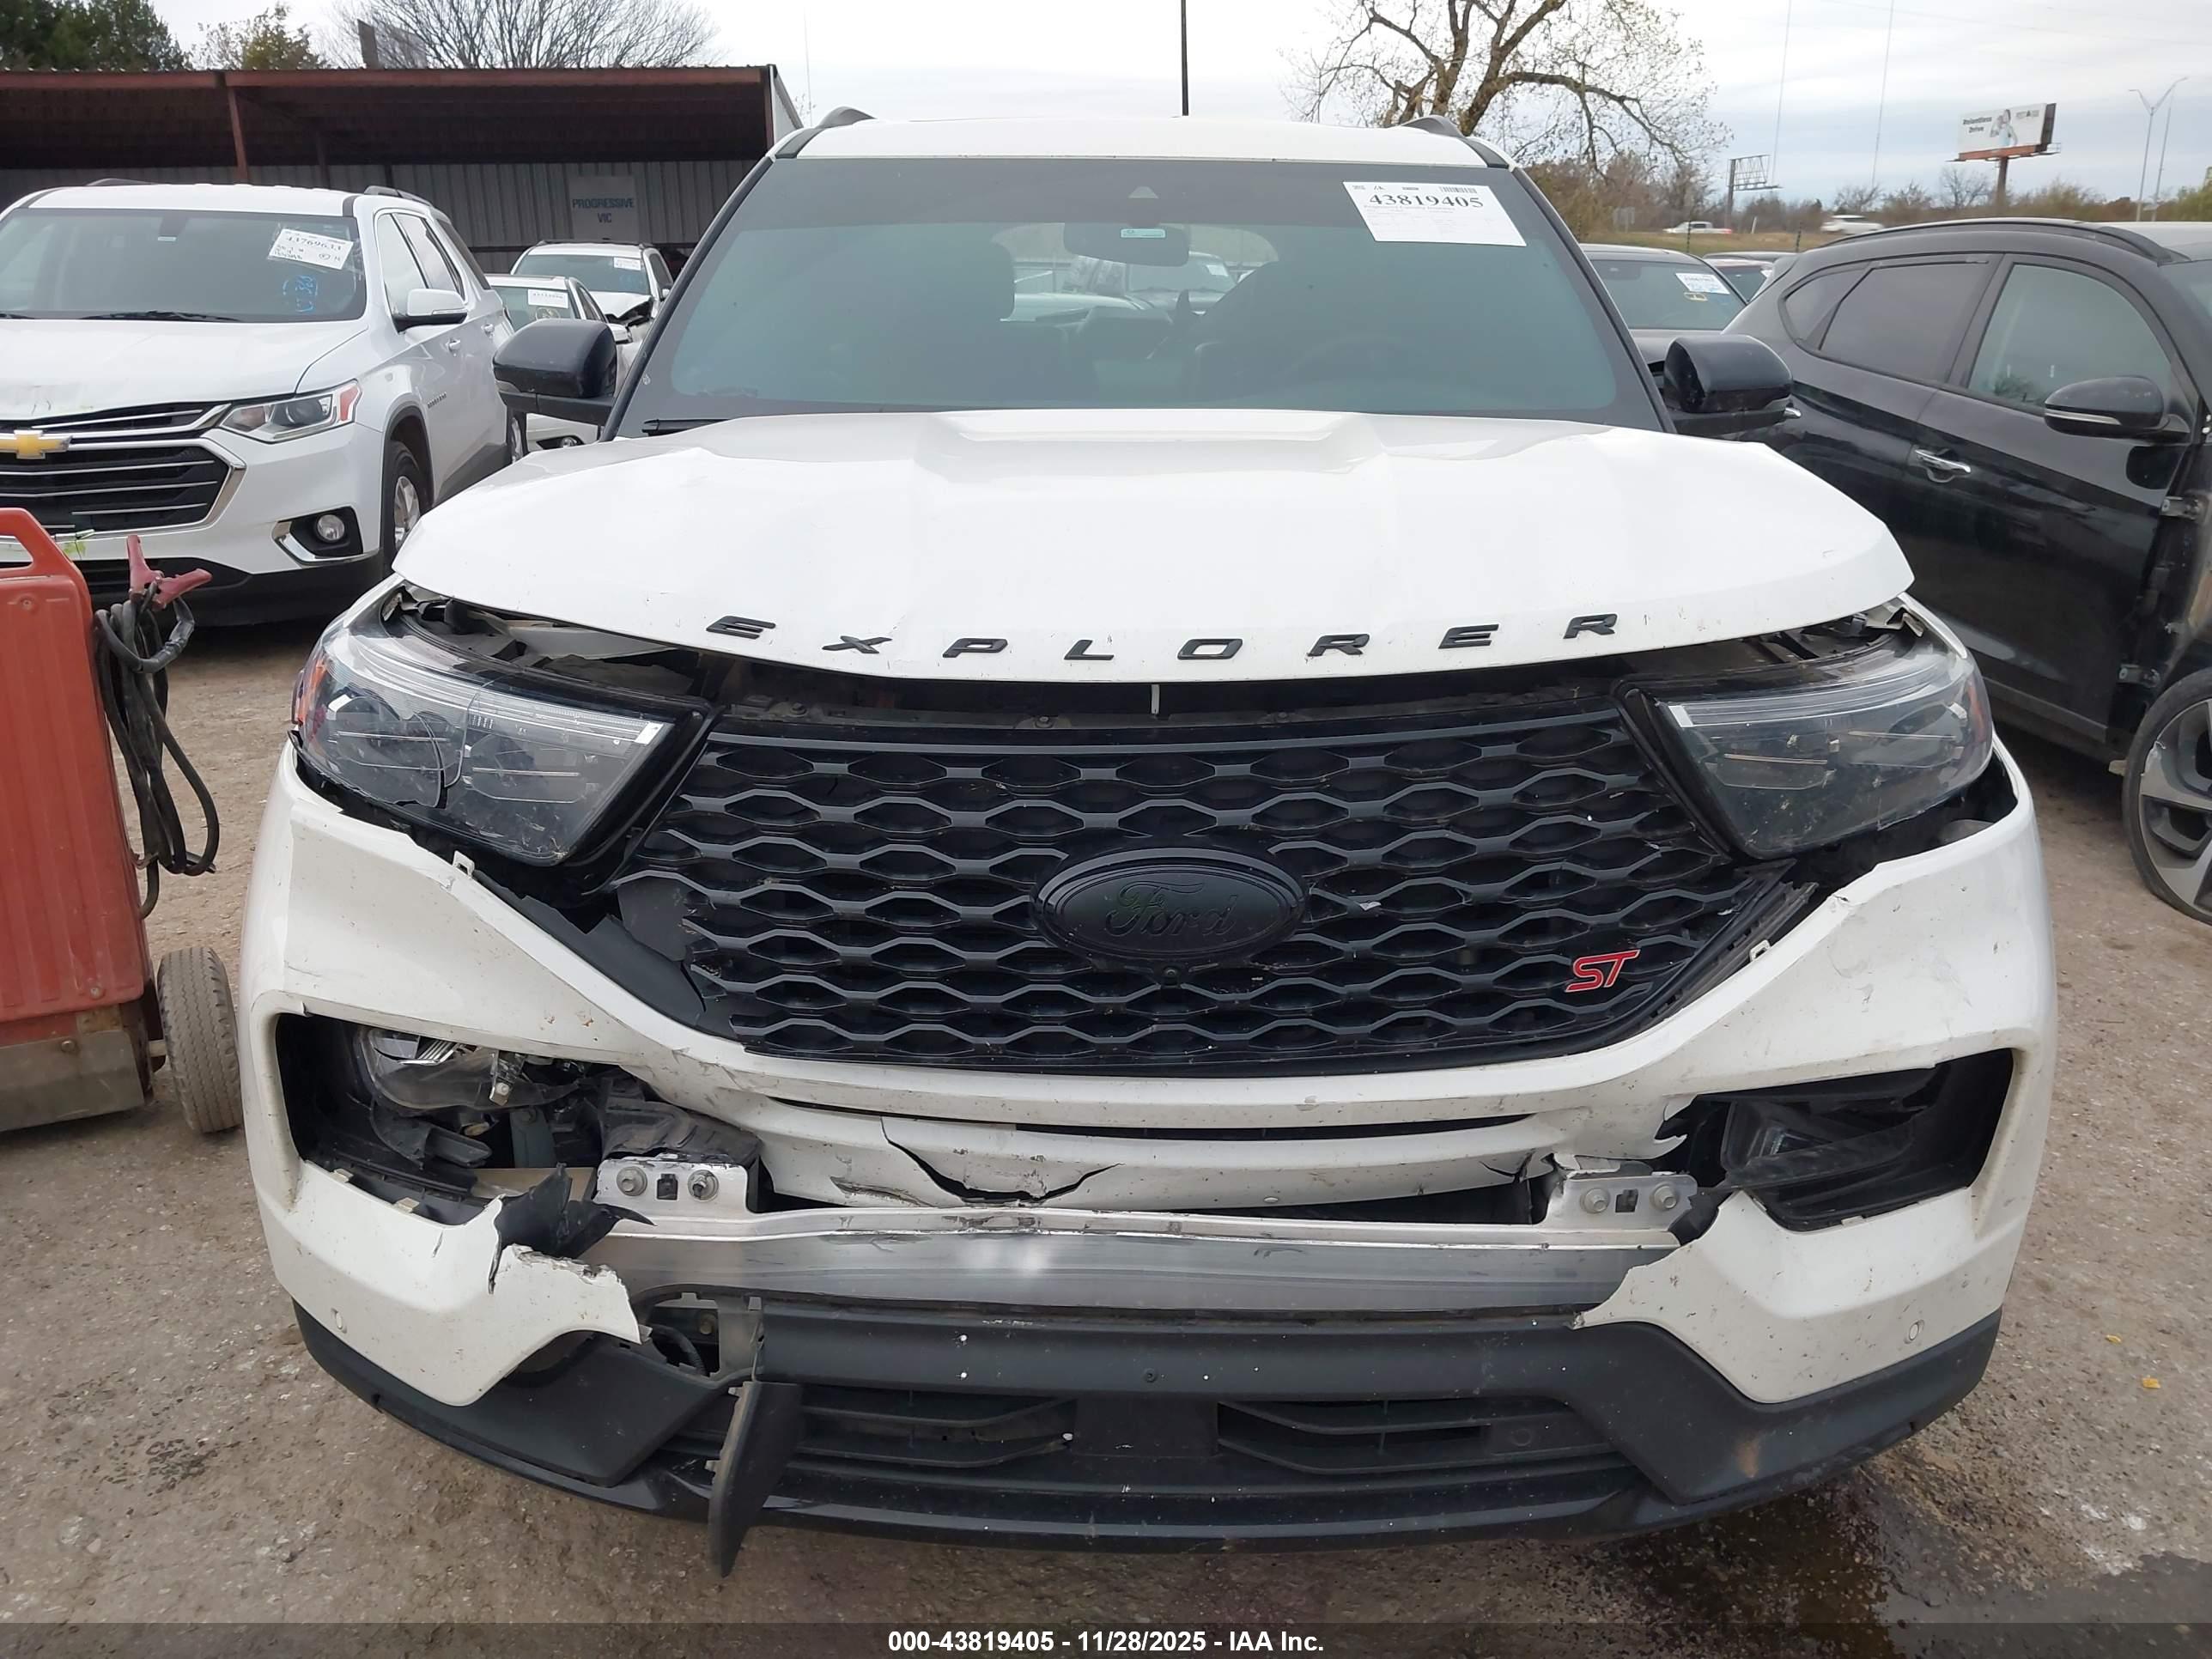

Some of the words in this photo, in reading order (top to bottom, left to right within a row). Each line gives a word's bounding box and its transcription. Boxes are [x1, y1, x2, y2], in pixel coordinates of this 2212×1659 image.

[572, 198, 634, 208] PROGRESSIVE
[1370, 194, 1484, 209] 43819405
[598, 213, 611, 223] VIC
[706, 612, 1619, 661] EXPLORER
[1106, 880, 1239, 936] Ford
[1565, 949, 1640, 993] ST
